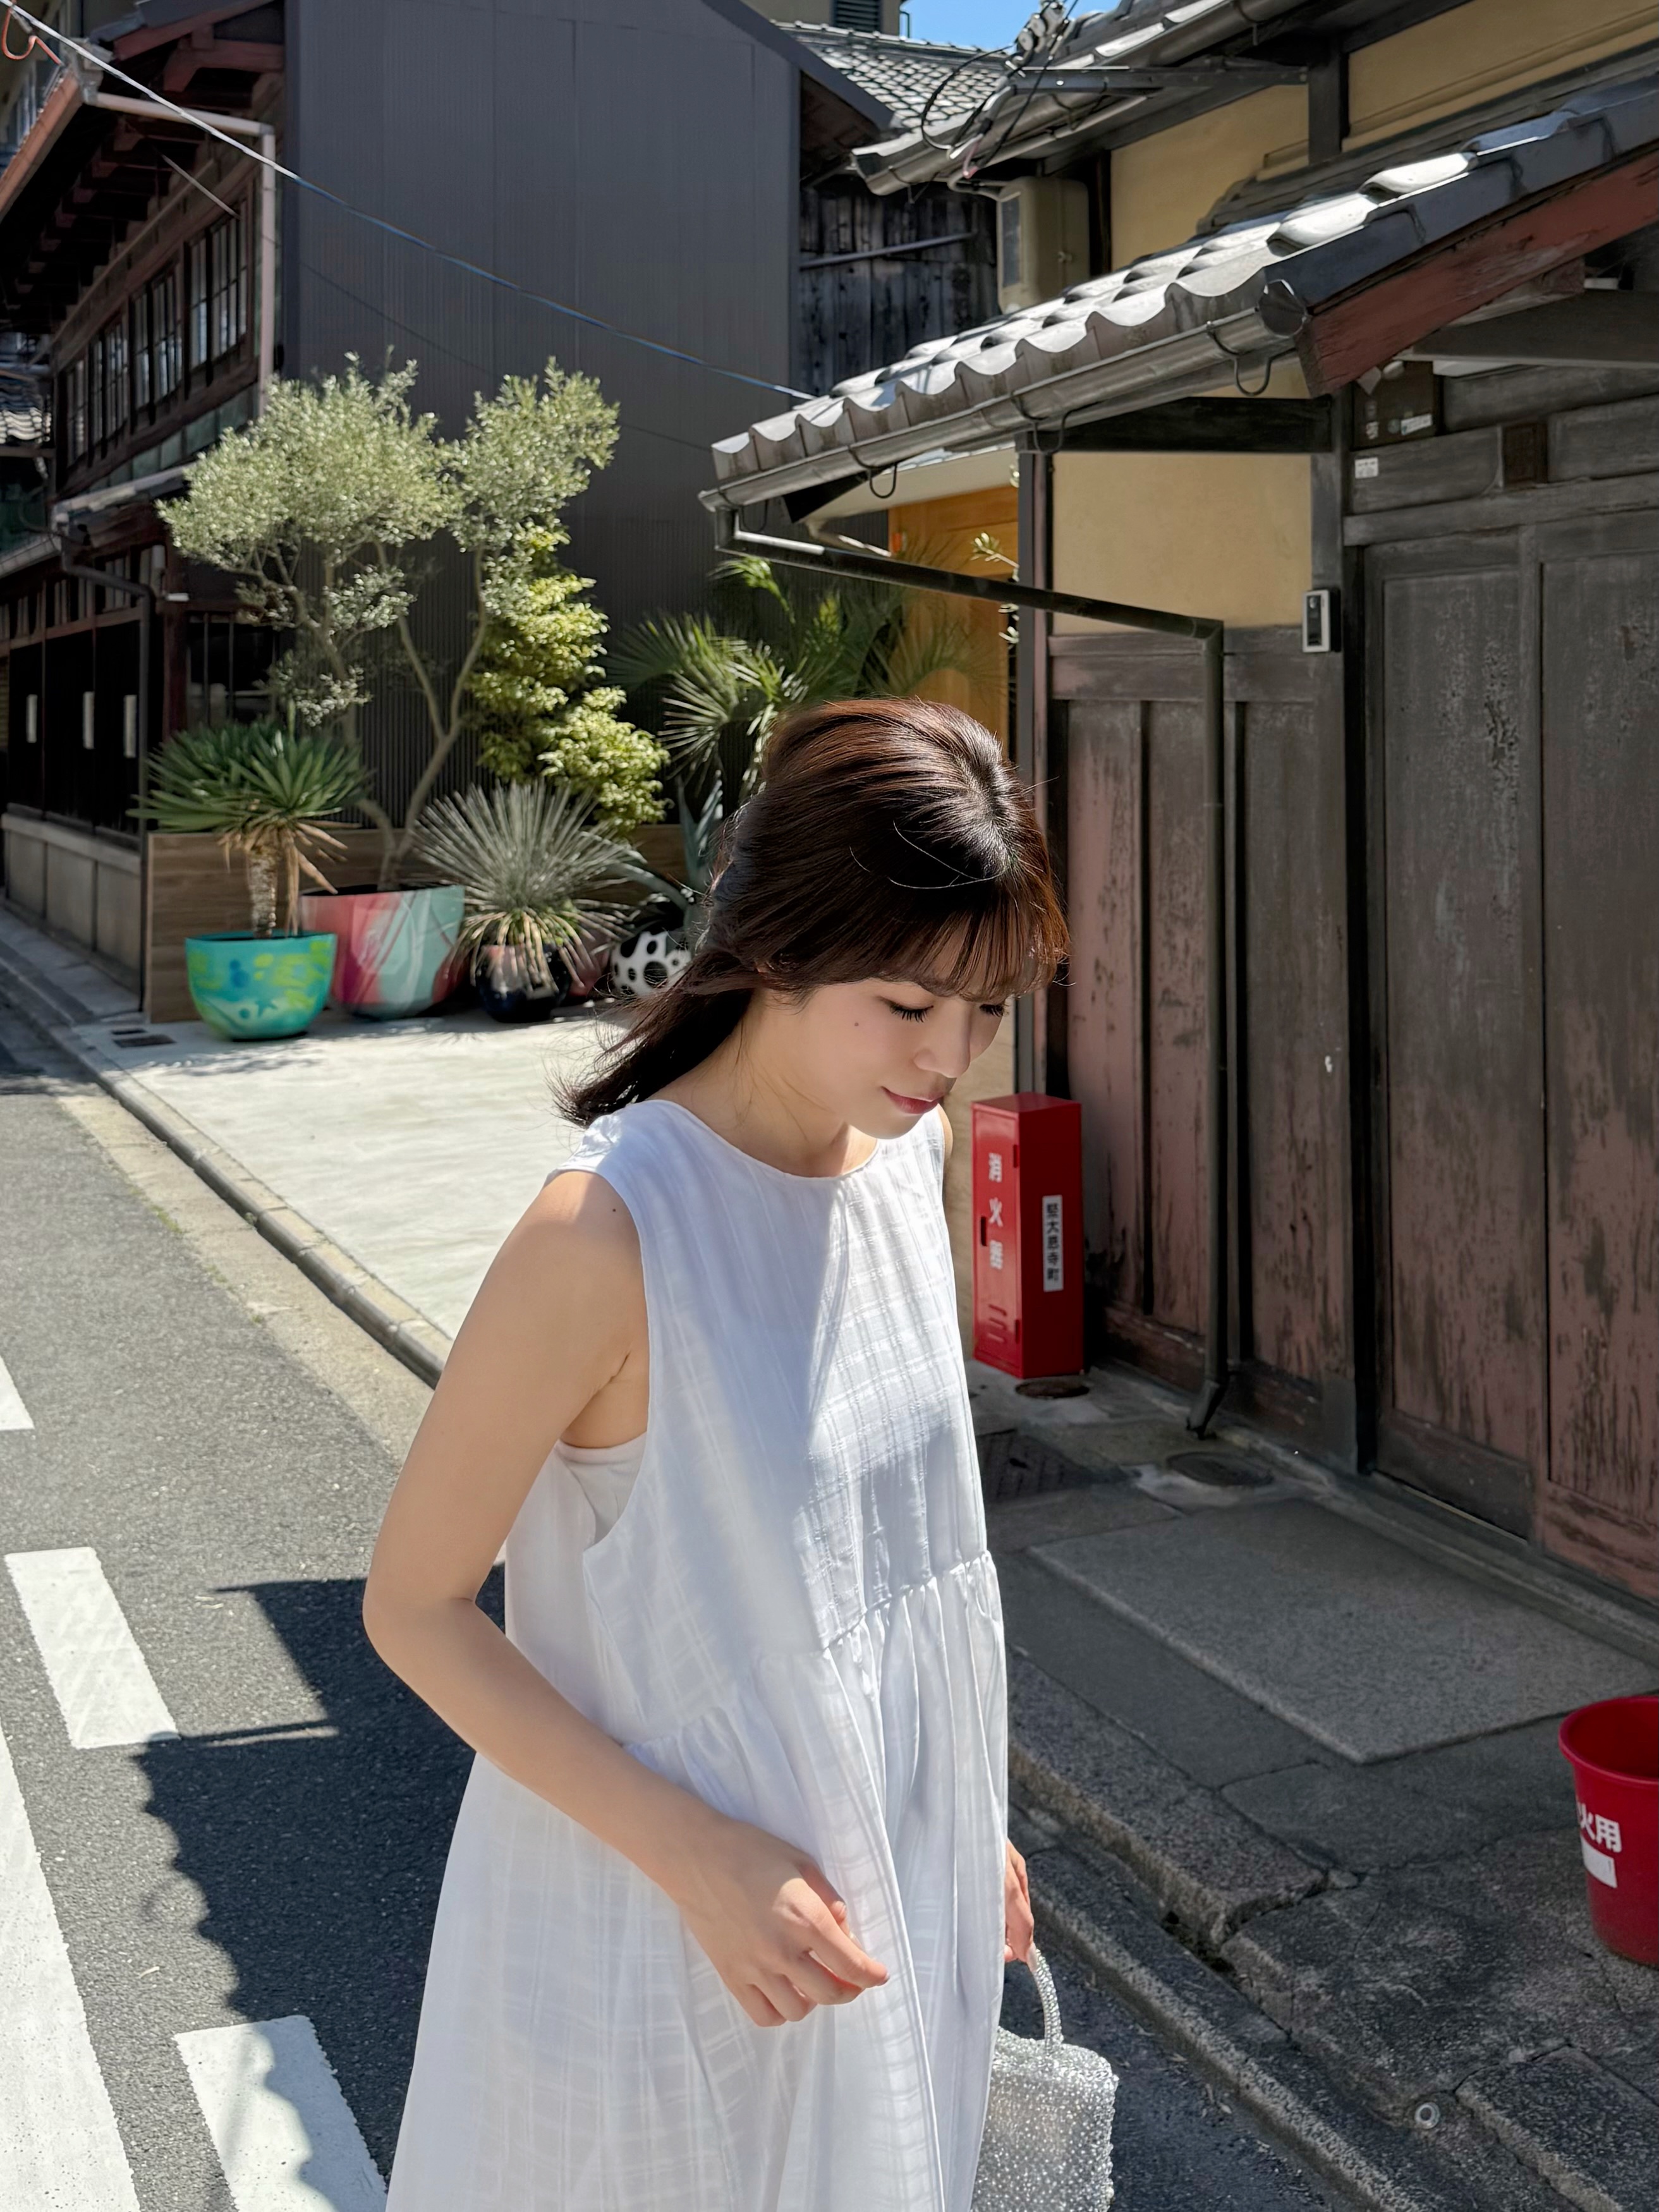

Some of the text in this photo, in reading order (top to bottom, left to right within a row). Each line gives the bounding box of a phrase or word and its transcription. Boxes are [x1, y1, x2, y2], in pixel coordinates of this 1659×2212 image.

[988, 1152, 1004, 1270] 消火器
[1577, 1799, 1622, 1853] 火用
